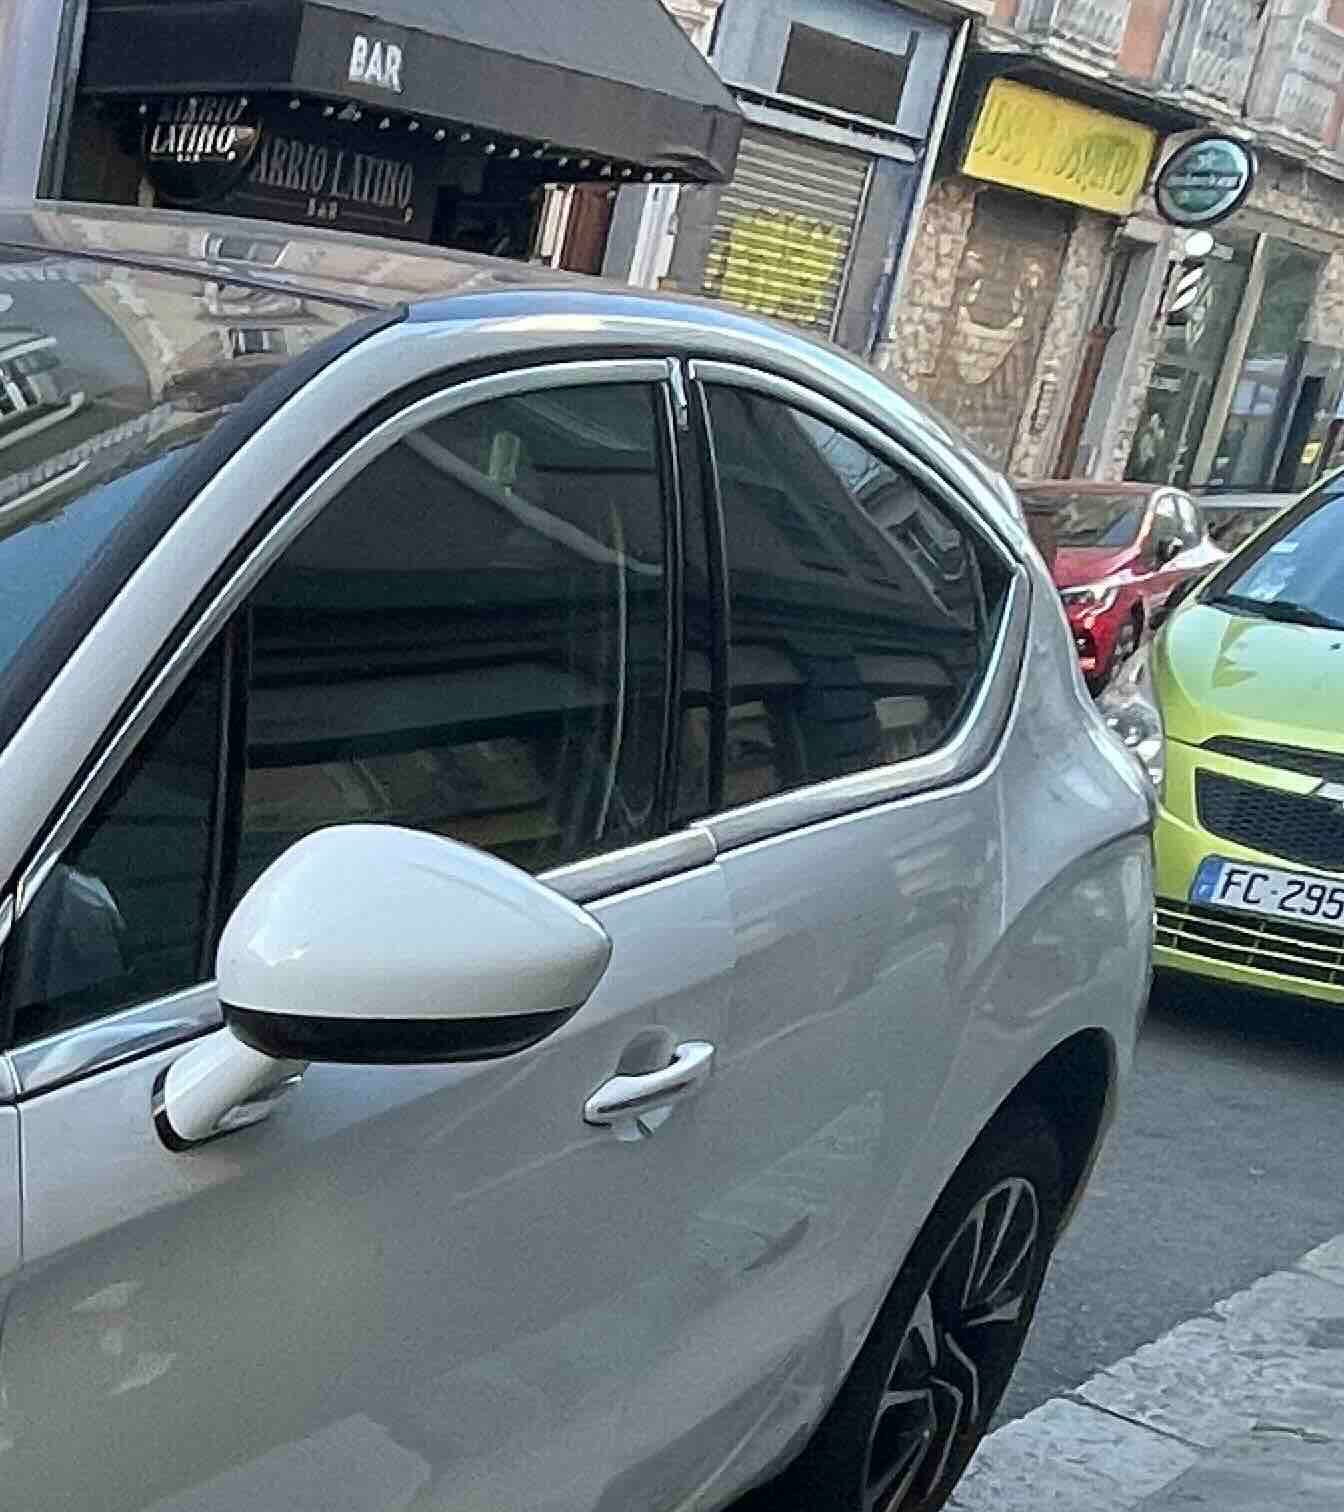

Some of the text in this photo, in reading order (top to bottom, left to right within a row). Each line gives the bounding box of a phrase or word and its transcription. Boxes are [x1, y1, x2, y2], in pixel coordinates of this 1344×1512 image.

[348, 34, 403, 94] BAR
[150, 123, 236, 153] LATINO
[248, 134, 329, 195] ARRIO
